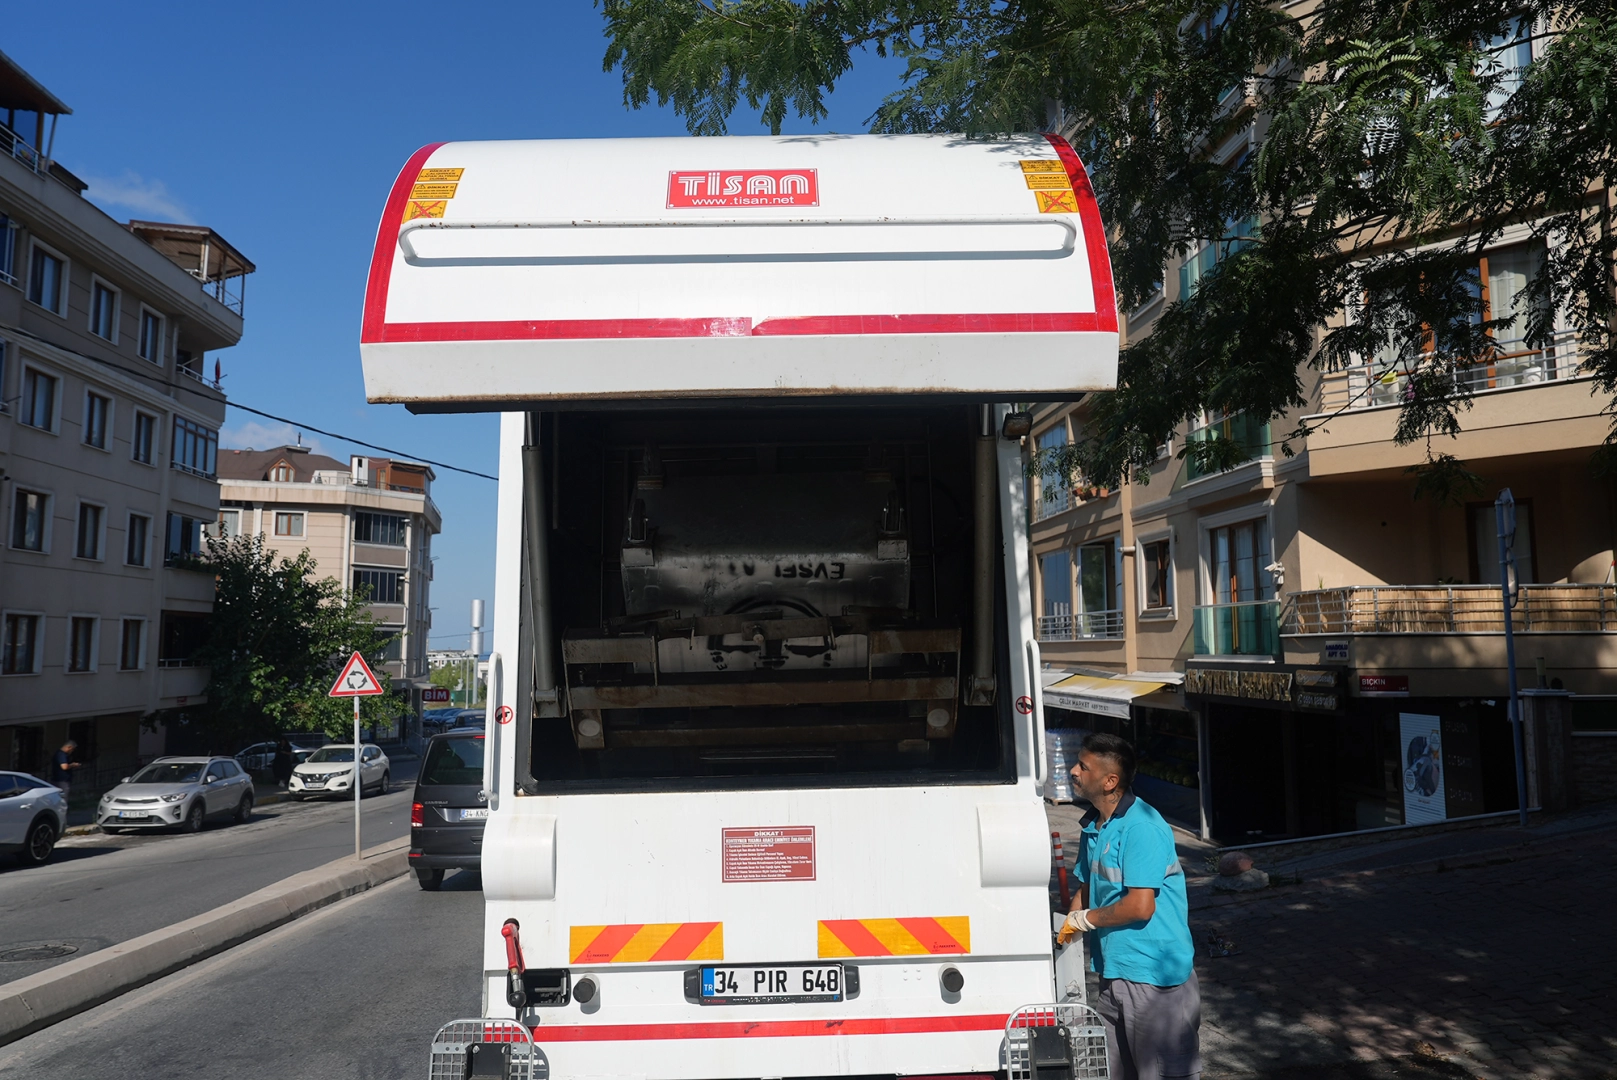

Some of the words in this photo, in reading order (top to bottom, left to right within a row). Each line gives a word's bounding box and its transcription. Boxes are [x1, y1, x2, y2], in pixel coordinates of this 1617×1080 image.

[678, 171, 809, 196] TİSAN
[1361, 678, 1386, 686] BIÇKIN
[424, 689, 447, 700] BİM
[1072, 700, 1090, 708] MARKET
[704, 984, 714, 992] TR
[715, 970, 738, 993] 34
[754, 970, 788, 993] PIR
[802, 970, 839, 993] 648
